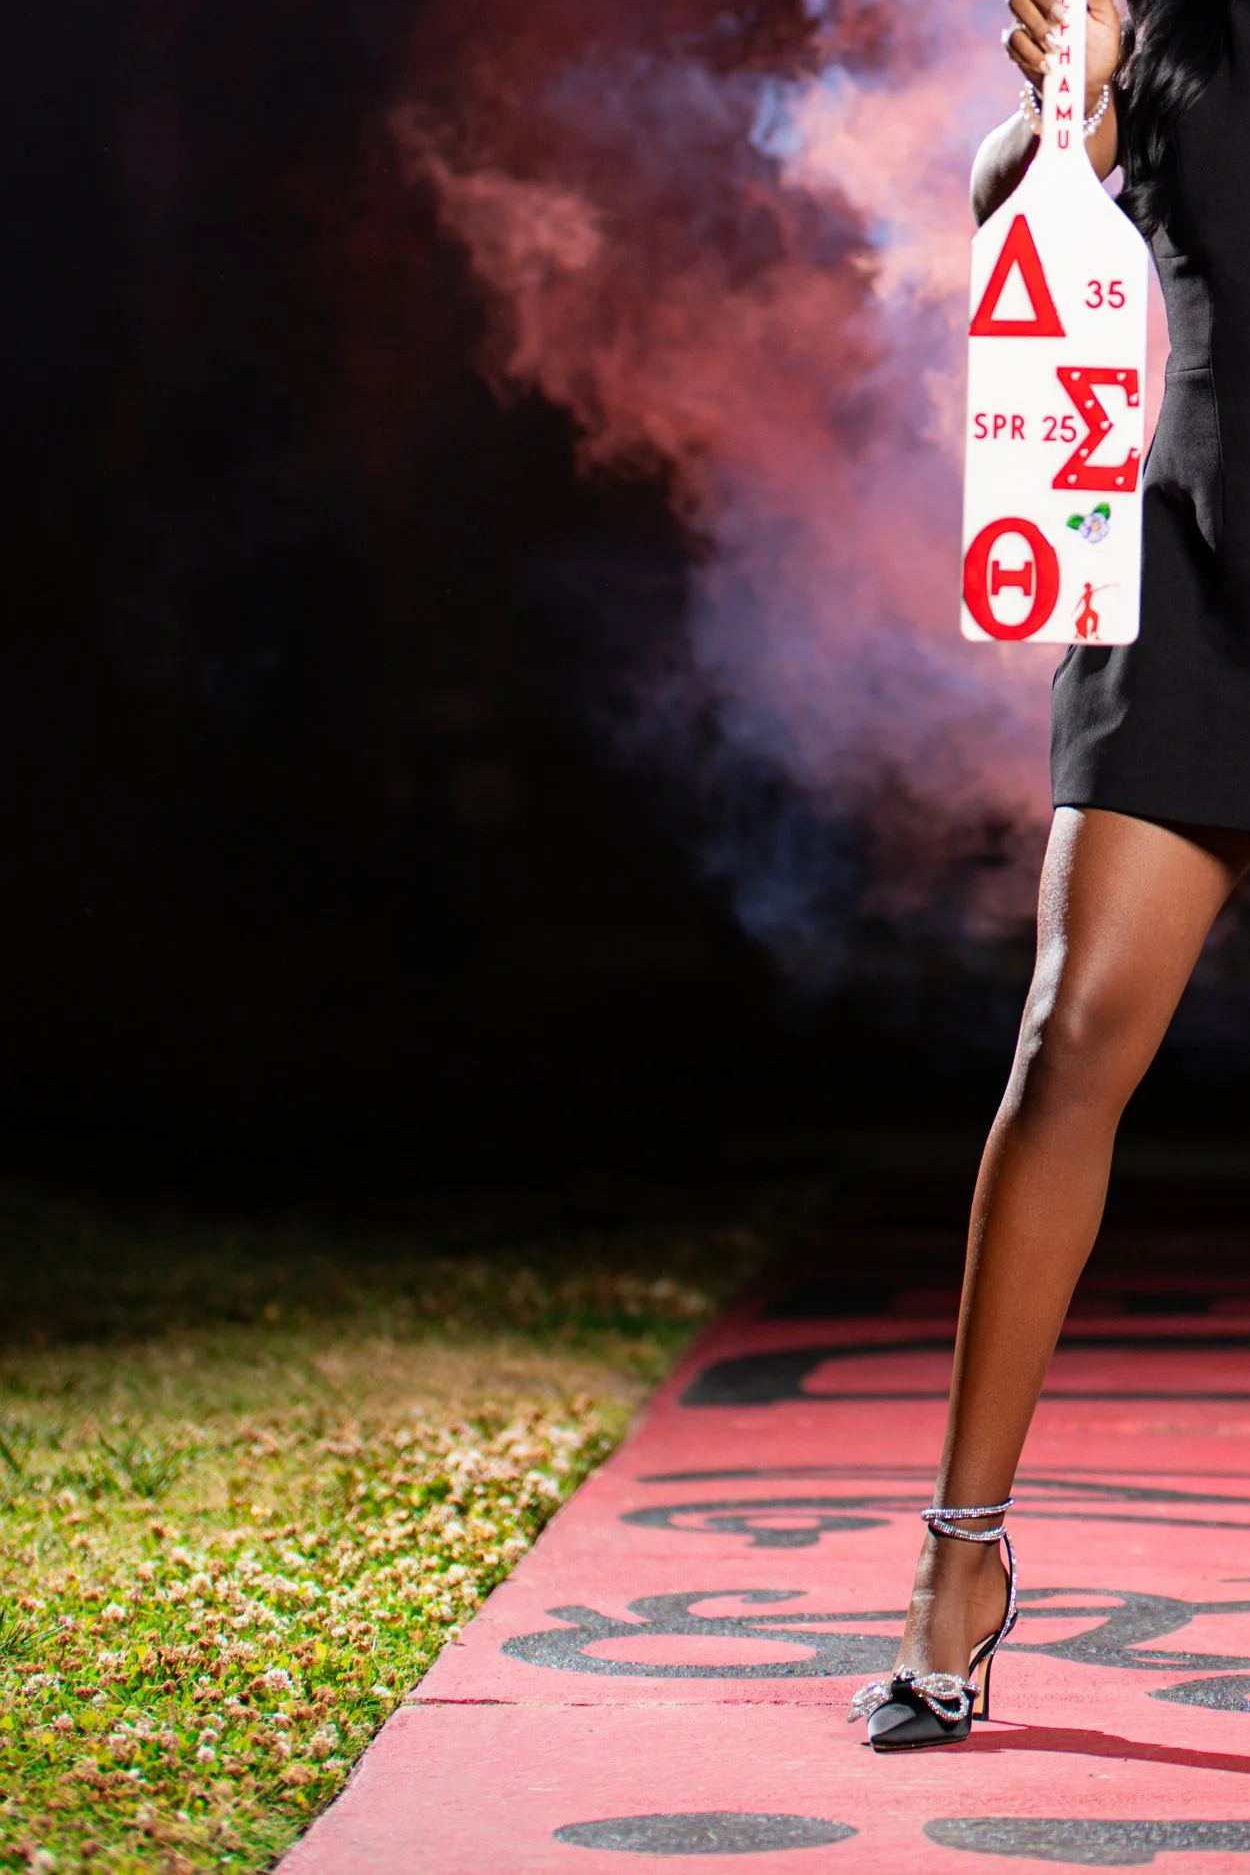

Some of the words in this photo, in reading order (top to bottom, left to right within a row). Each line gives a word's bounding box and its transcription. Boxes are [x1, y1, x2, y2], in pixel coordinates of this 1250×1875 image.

[1085, 280, 1126, 310] 35
[973, 412, 1026, 441] SPR
[1042, 415, 1078, 443] 25
